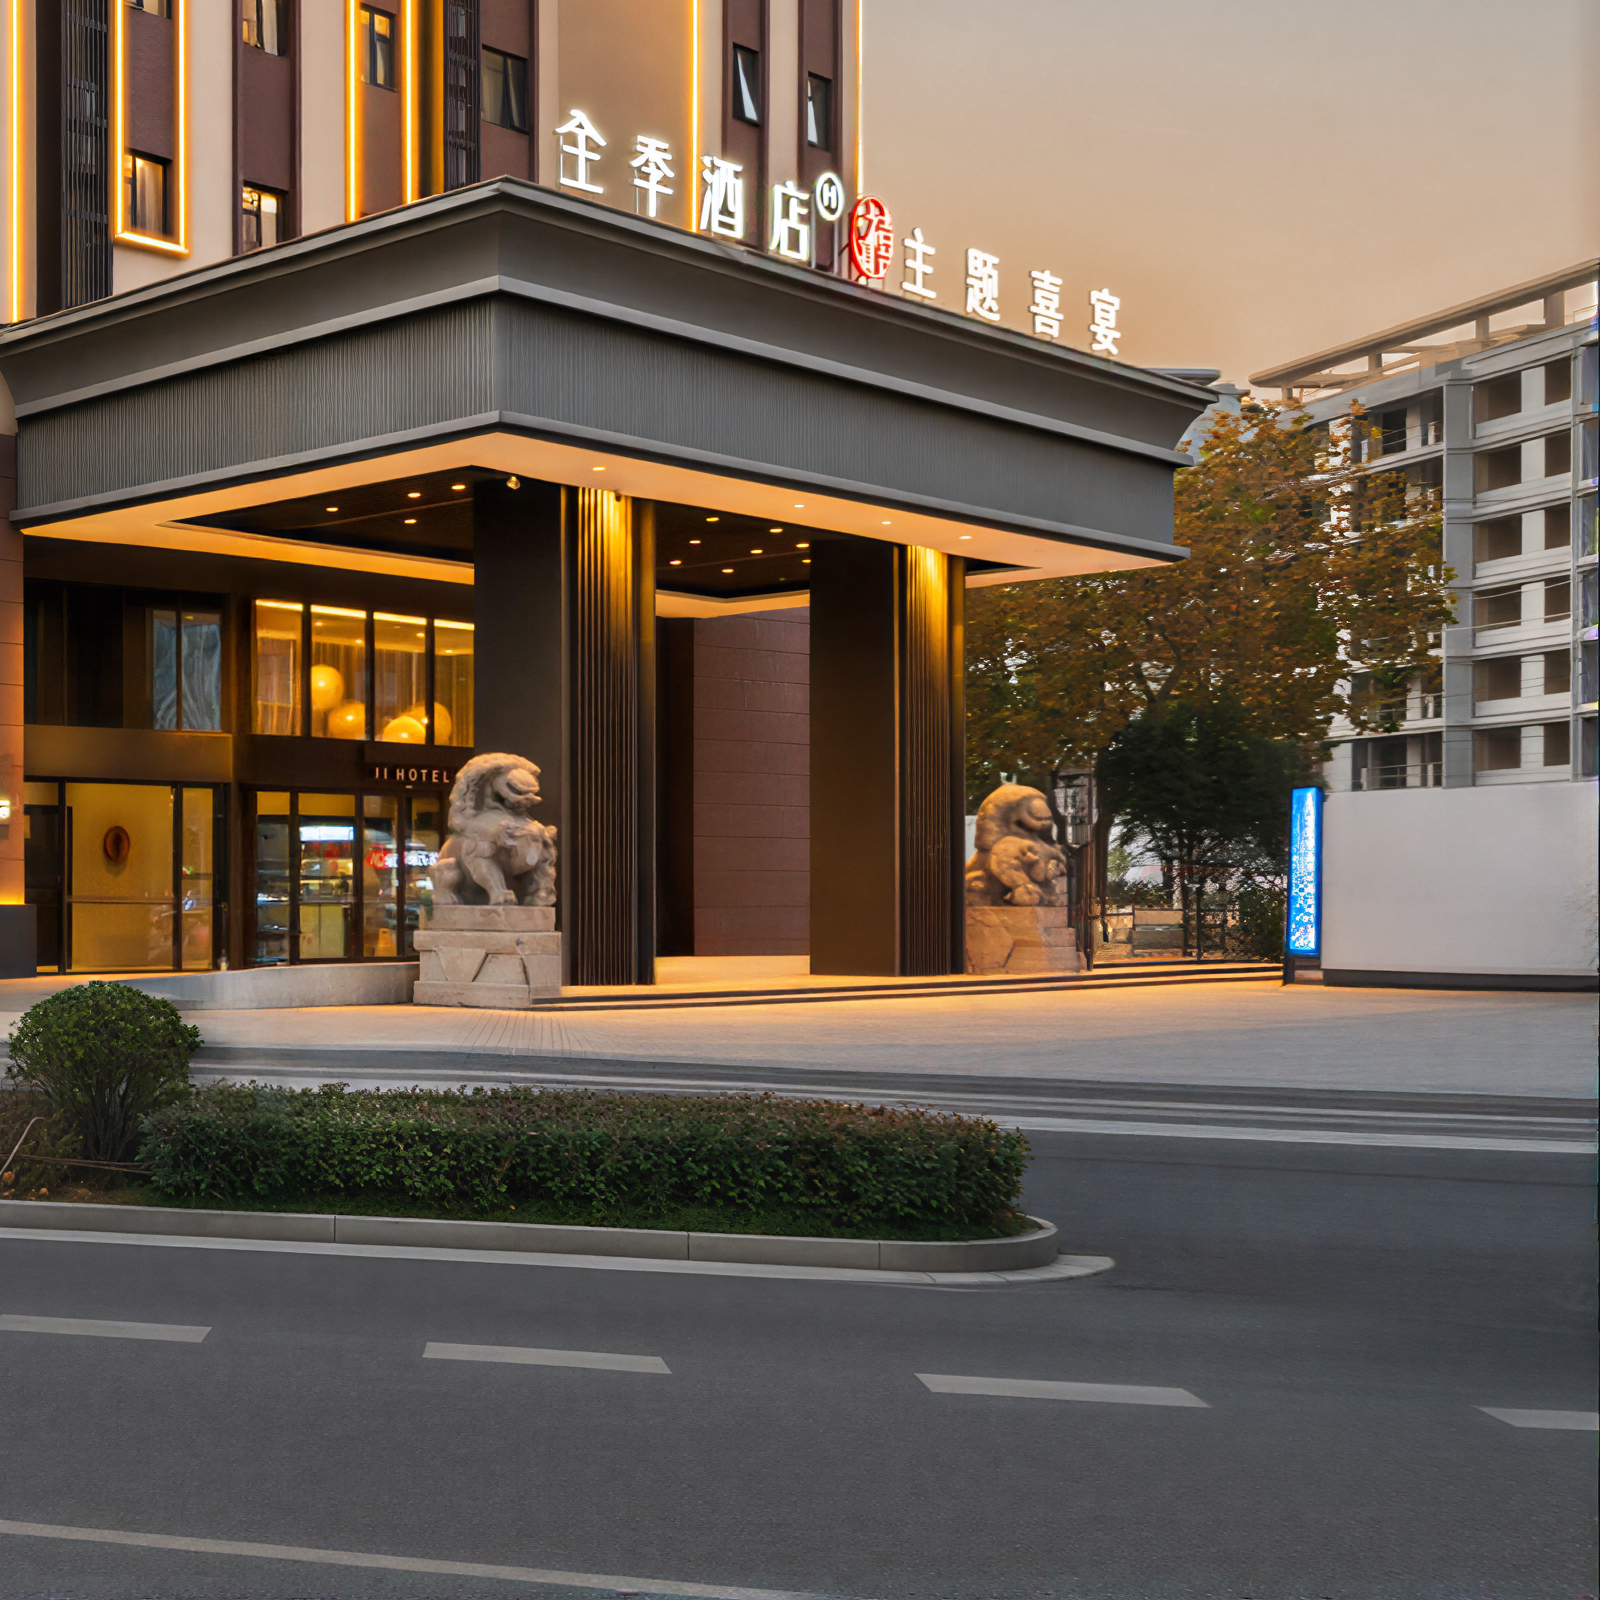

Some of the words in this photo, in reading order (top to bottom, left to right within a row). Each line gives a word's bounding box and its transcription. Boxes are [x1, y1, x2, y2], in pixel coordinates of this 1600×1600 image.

[553, 108, 811, 262] 全季酒店
[901, 227, 1121, 355] 主题喜宴
[396, 768, 450, 784] HOTEL
